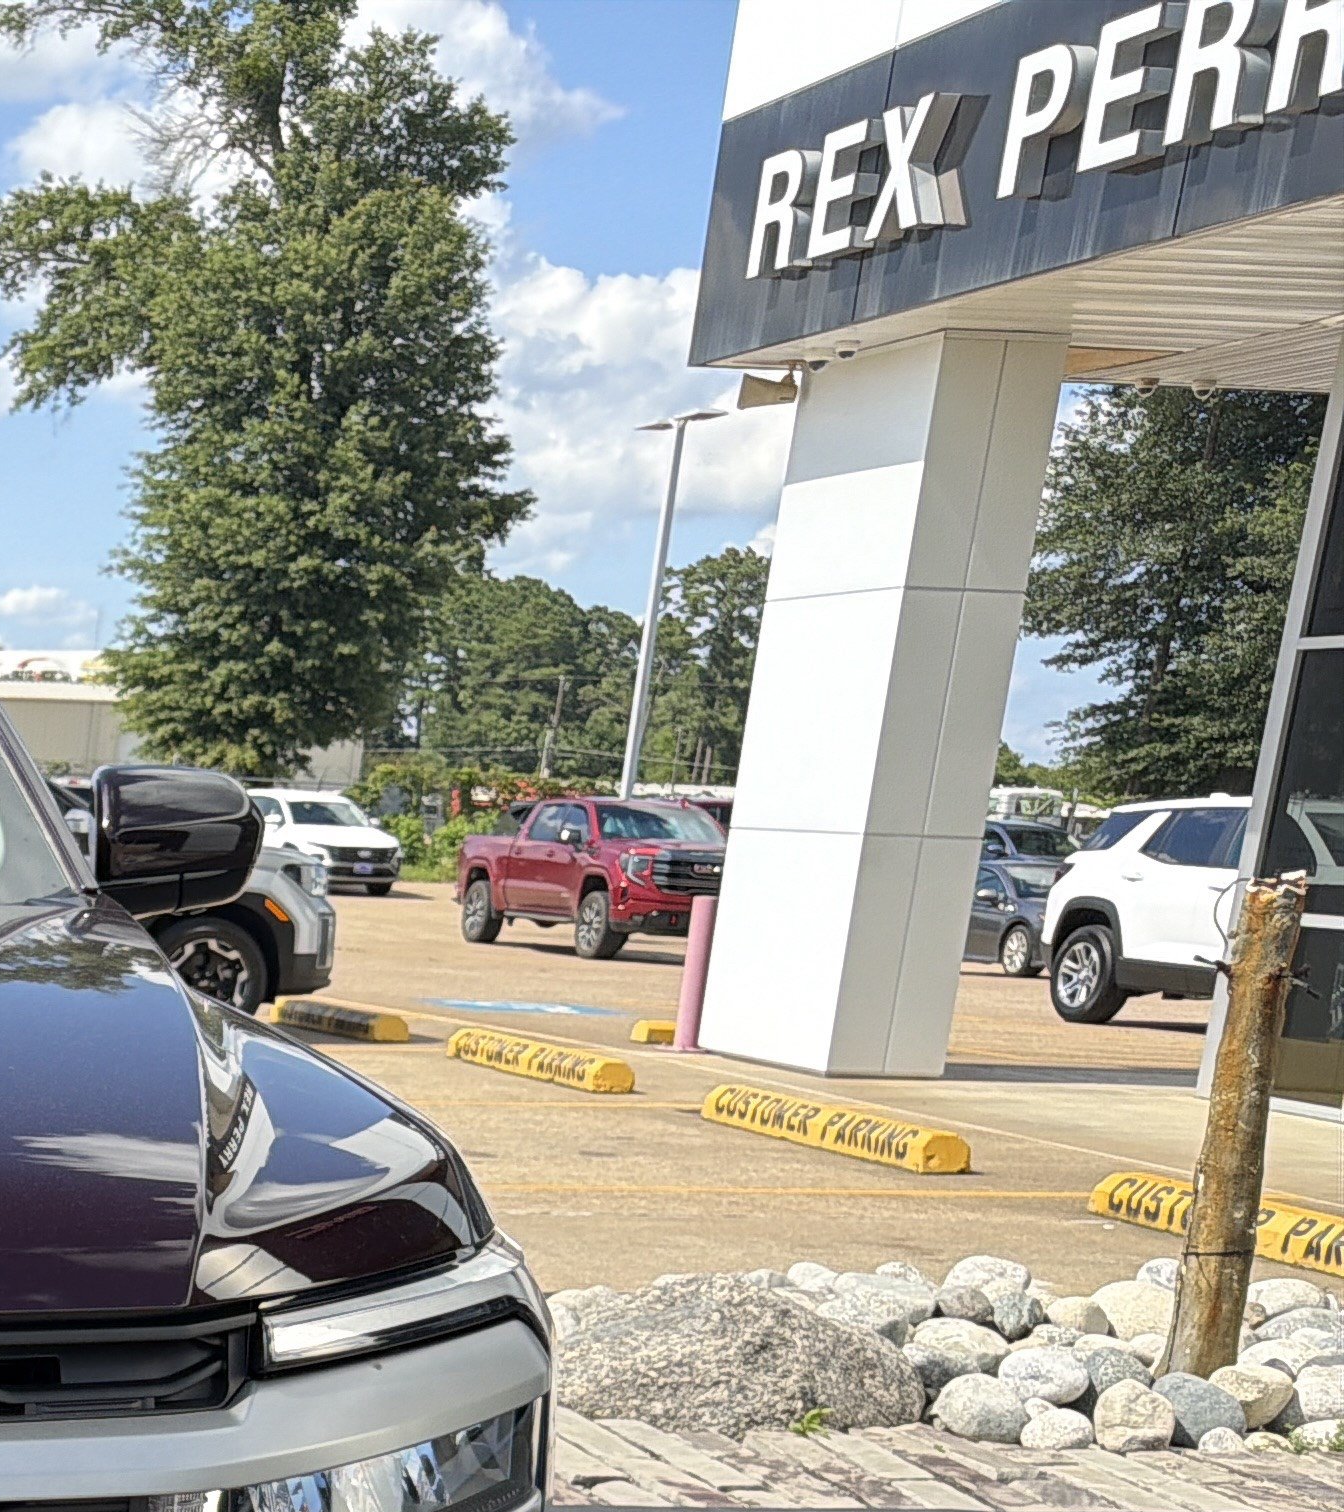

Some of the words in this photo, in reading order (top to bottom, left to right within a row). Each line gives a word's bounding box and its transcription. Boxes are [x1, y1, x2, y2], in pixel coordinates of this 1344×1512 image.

[746, 92, 940, 280] REX
[455, 1031, 530, 1066] CUSTOMER
[527, 1047, 596, 1082] PARKING
[714, 1087, 821, 1137] CUSTOMER
[820, 1112, 920, 1161] PARKING
